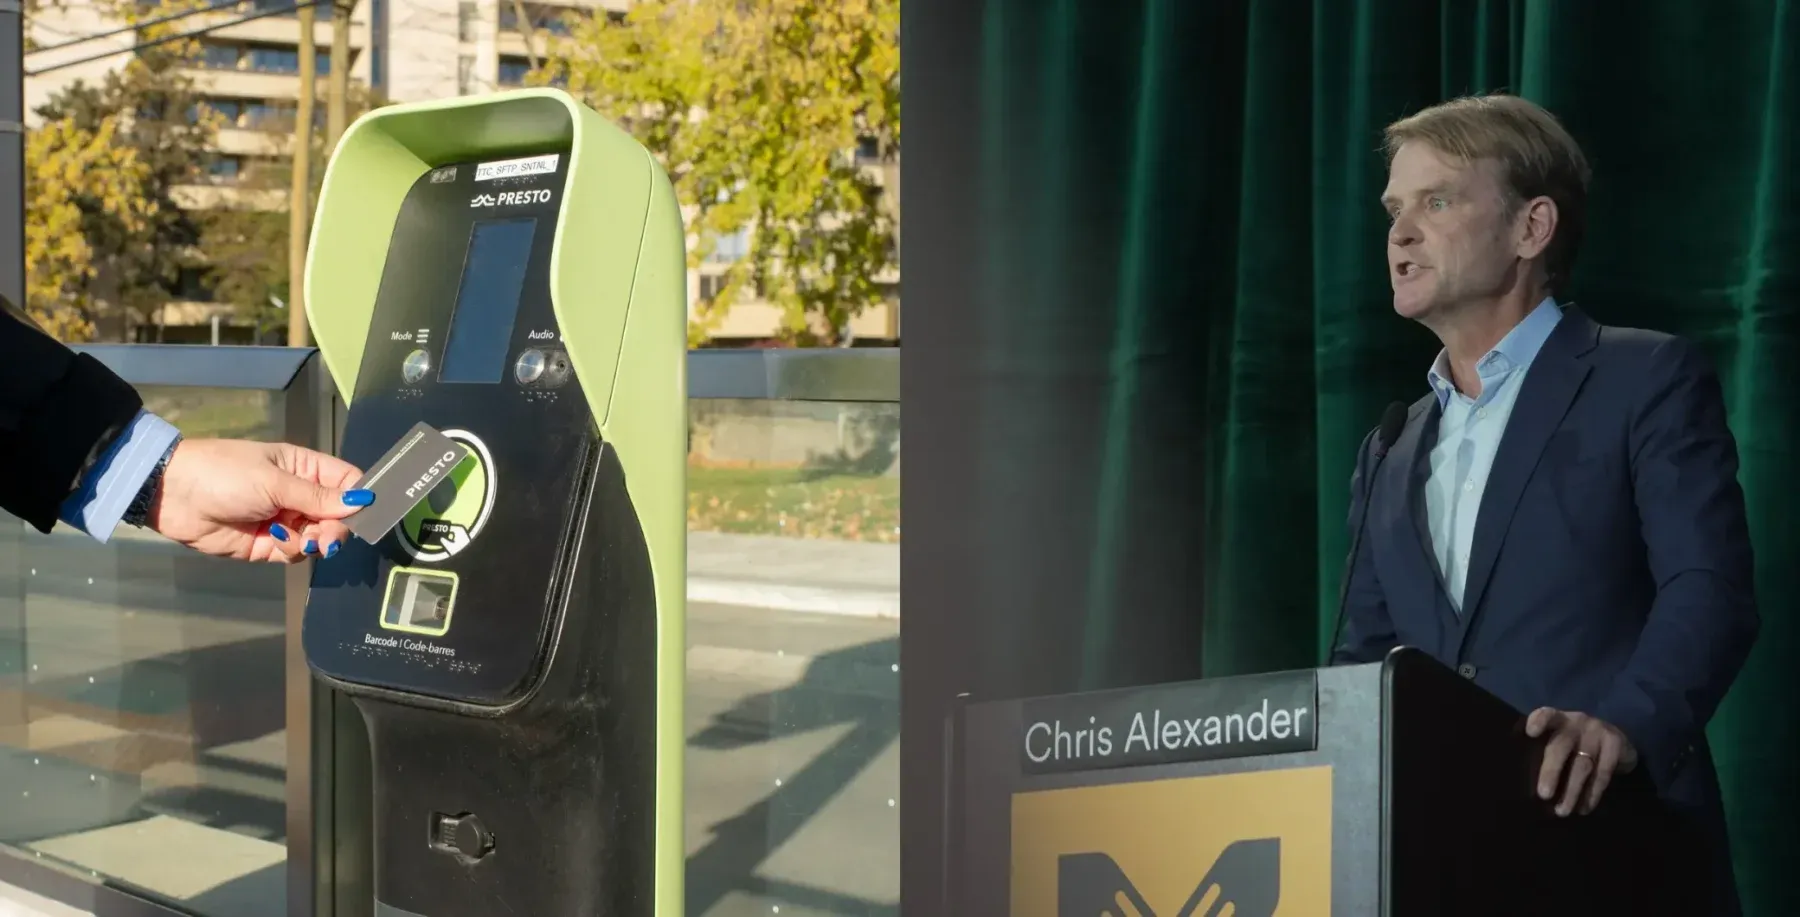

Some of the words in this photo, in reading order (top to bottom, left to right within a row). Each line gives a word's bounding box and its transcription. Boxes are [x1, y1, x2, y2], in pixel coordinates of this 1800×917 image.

[497, 189, 551, 206] PRESTO
[391, 331, 413, 341] Mode
[528, 329, 554, 340] Audio
[405, 450, 456, 498] PRESTO
[422, 523, 449, 533] PRESTO
[364, 633, 398, 647] Barcode
[403, 638, 456, 656] Code-barres
[1025, 716, 1112, 763] Chris
[1124, 699, 1308, 753] Alexander
